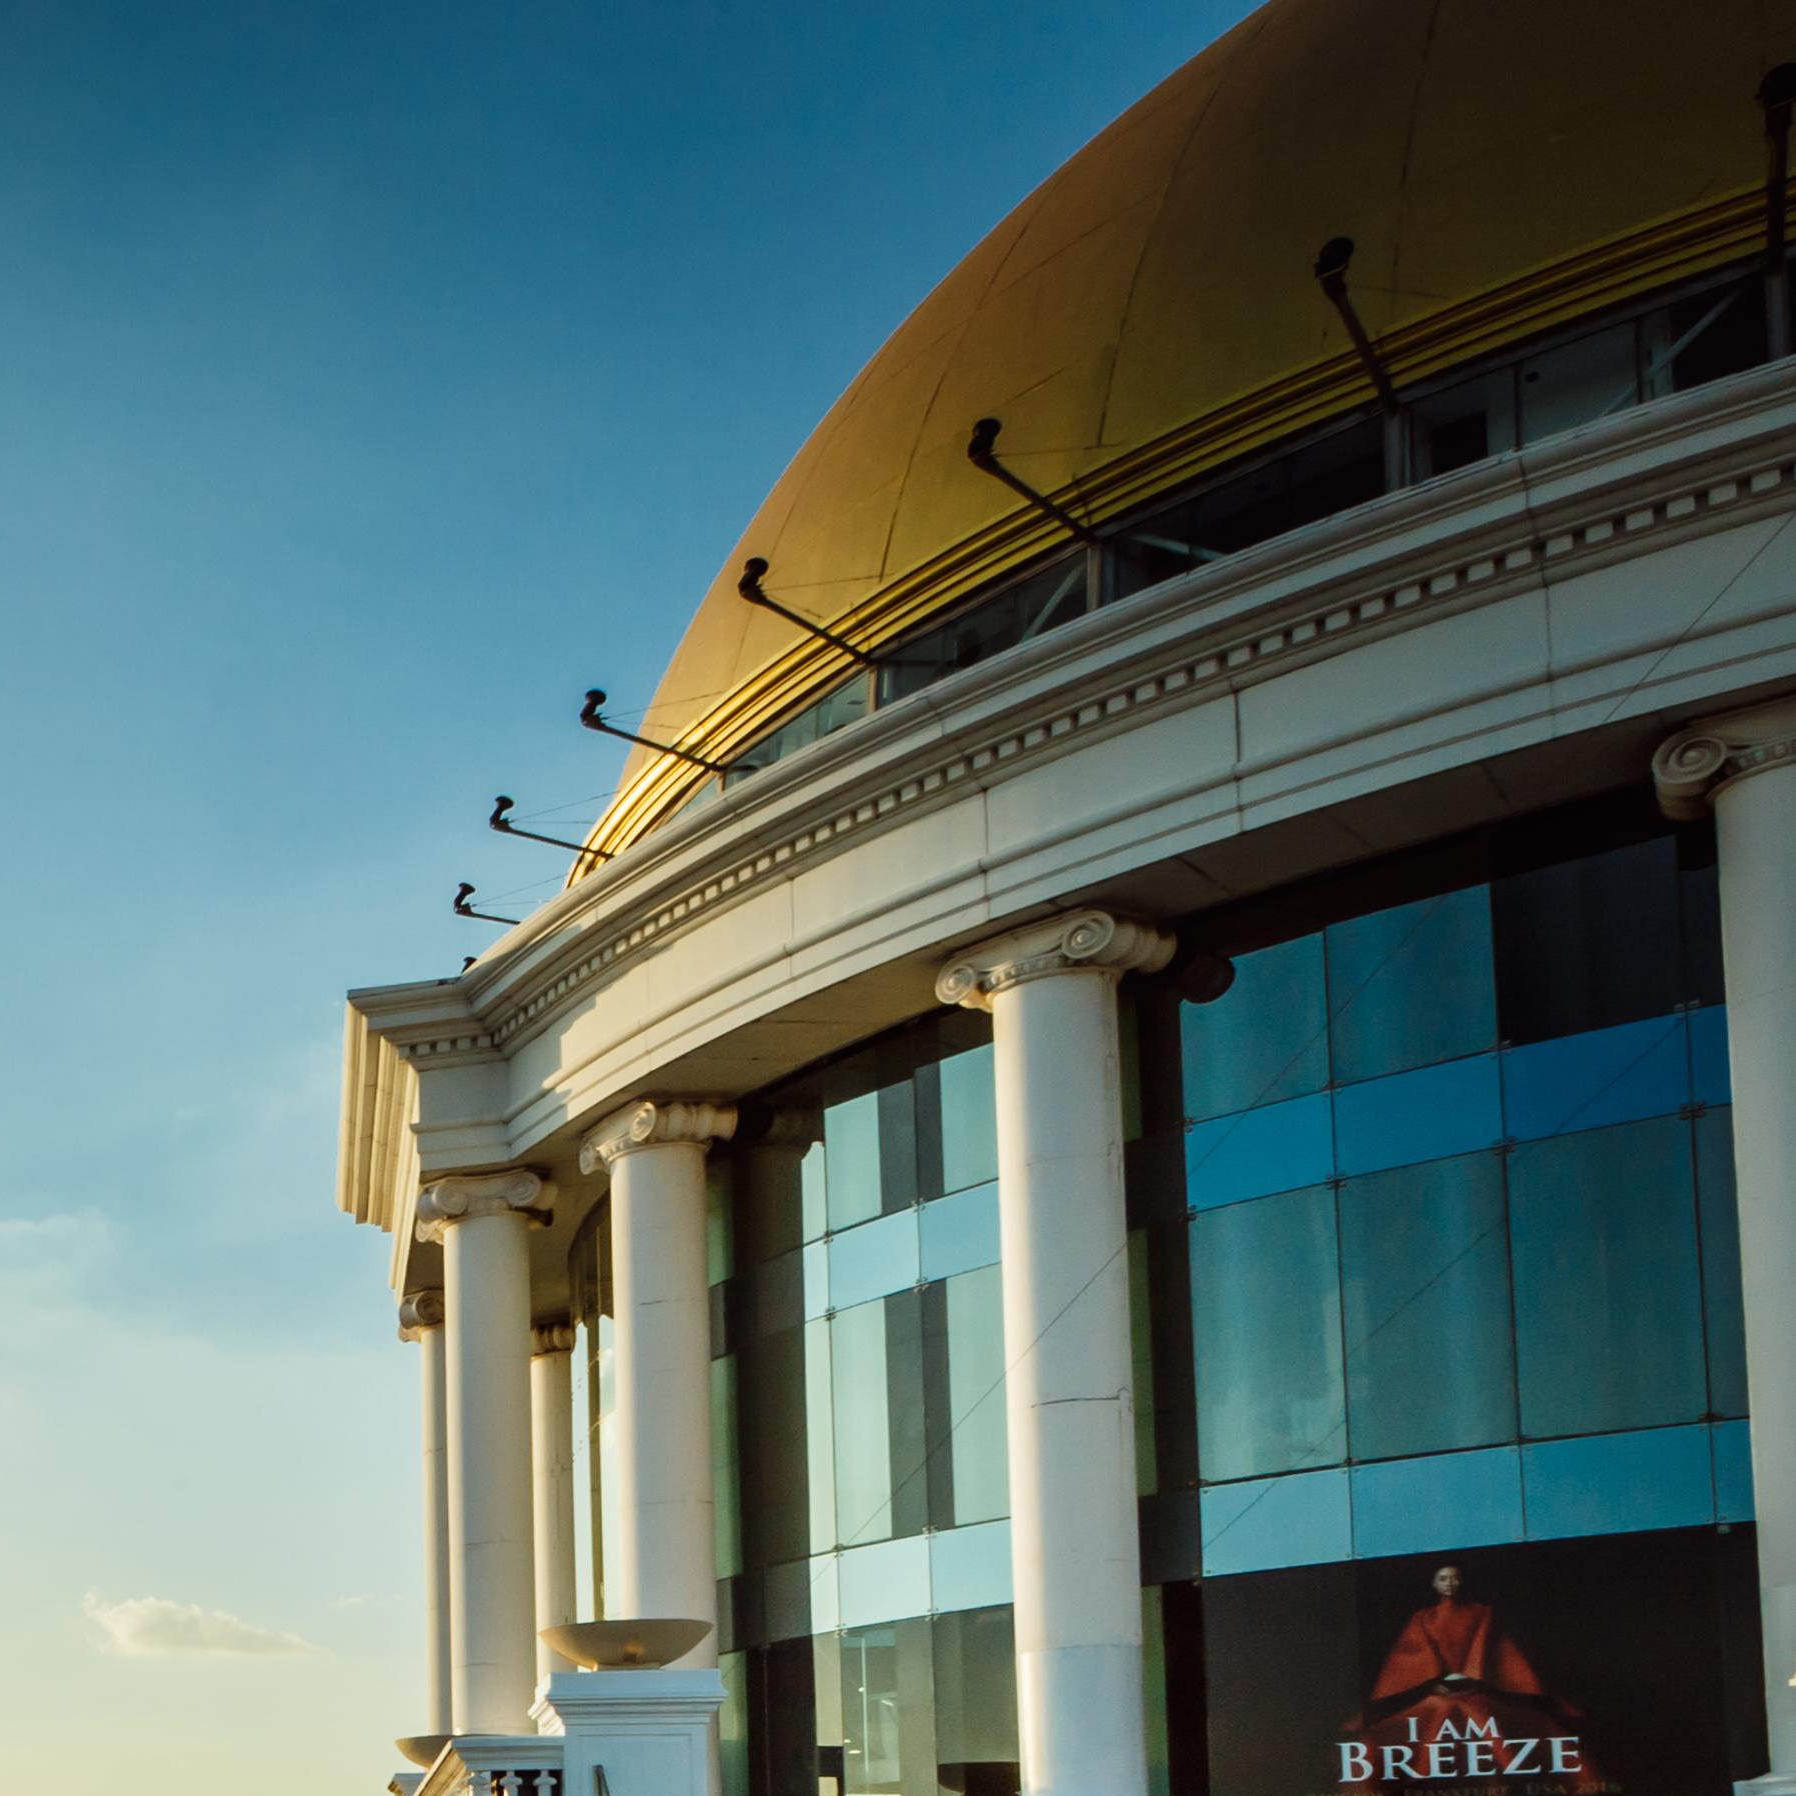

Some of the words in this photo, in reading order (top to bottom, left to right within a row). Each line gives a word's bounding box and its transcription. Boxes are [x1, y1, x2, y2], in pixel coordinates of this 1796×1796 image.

[1407, 1716, 1419, 1742] I
[1433, 1715, 1501, 1741] AM
[1335, 1736, 1583, 1783] BREEZE
